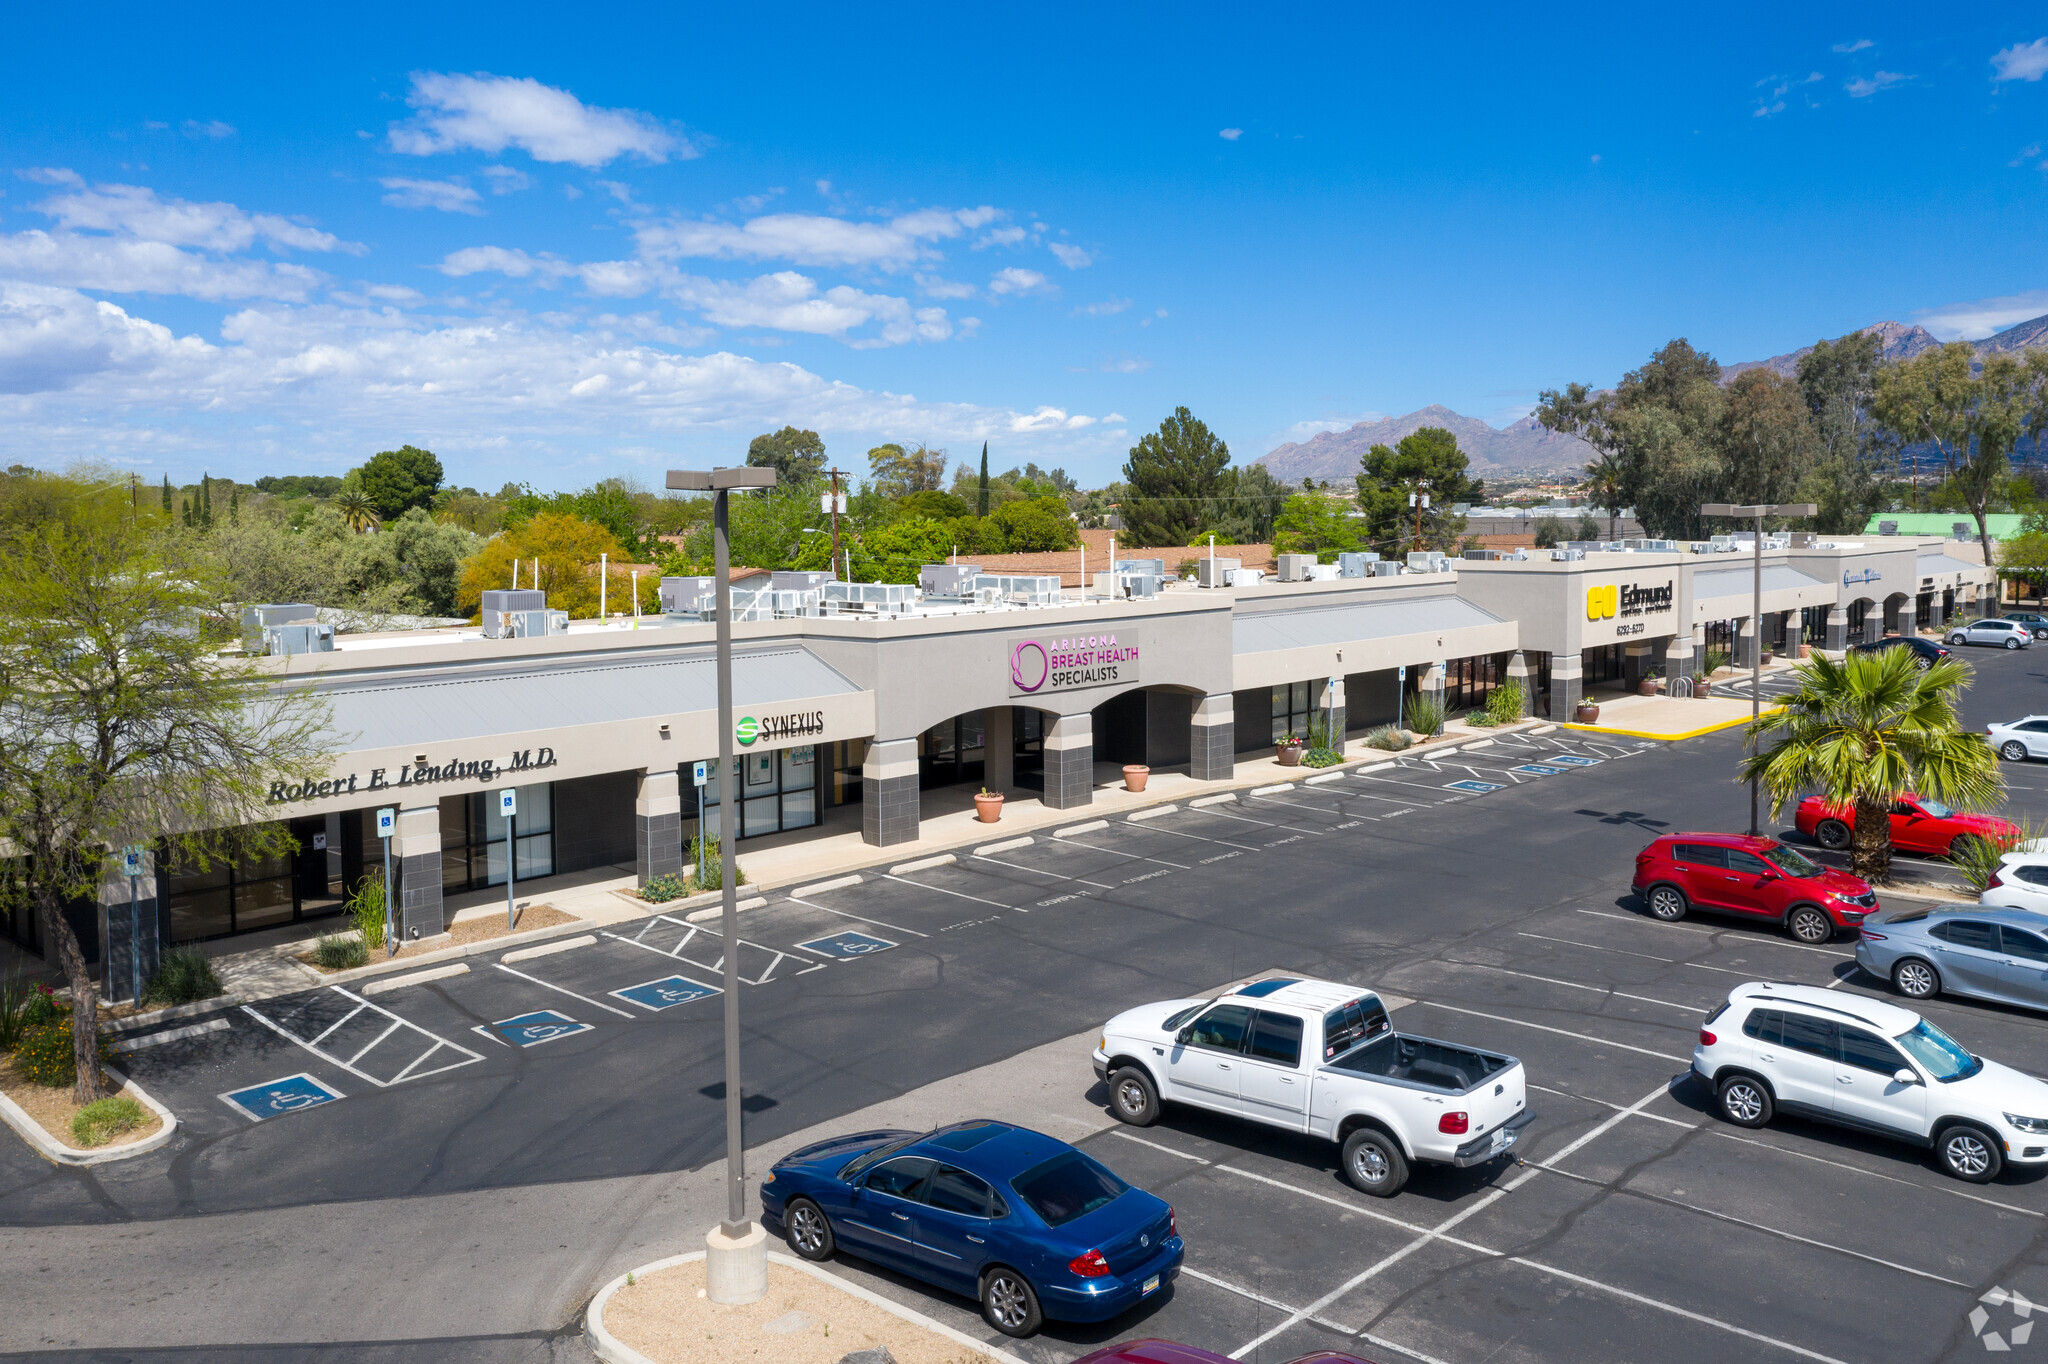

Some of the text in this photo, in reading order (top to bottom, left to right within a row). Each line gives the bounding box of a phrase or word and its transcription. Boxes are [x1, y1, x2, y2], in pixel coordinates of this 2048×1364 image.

[1621, 580, 1672, 608] Edmund
[1050, 634, 1118, 652] ARIZONA
[1051, 647, 1139, 669] BREAST HEALTH
[1051, 666, 1118, 687] SPECIALISTS
[762, 711, 823, 738] SYNEXUS
[266, 747, 558, 801] Robert E. Lending, M.D.
